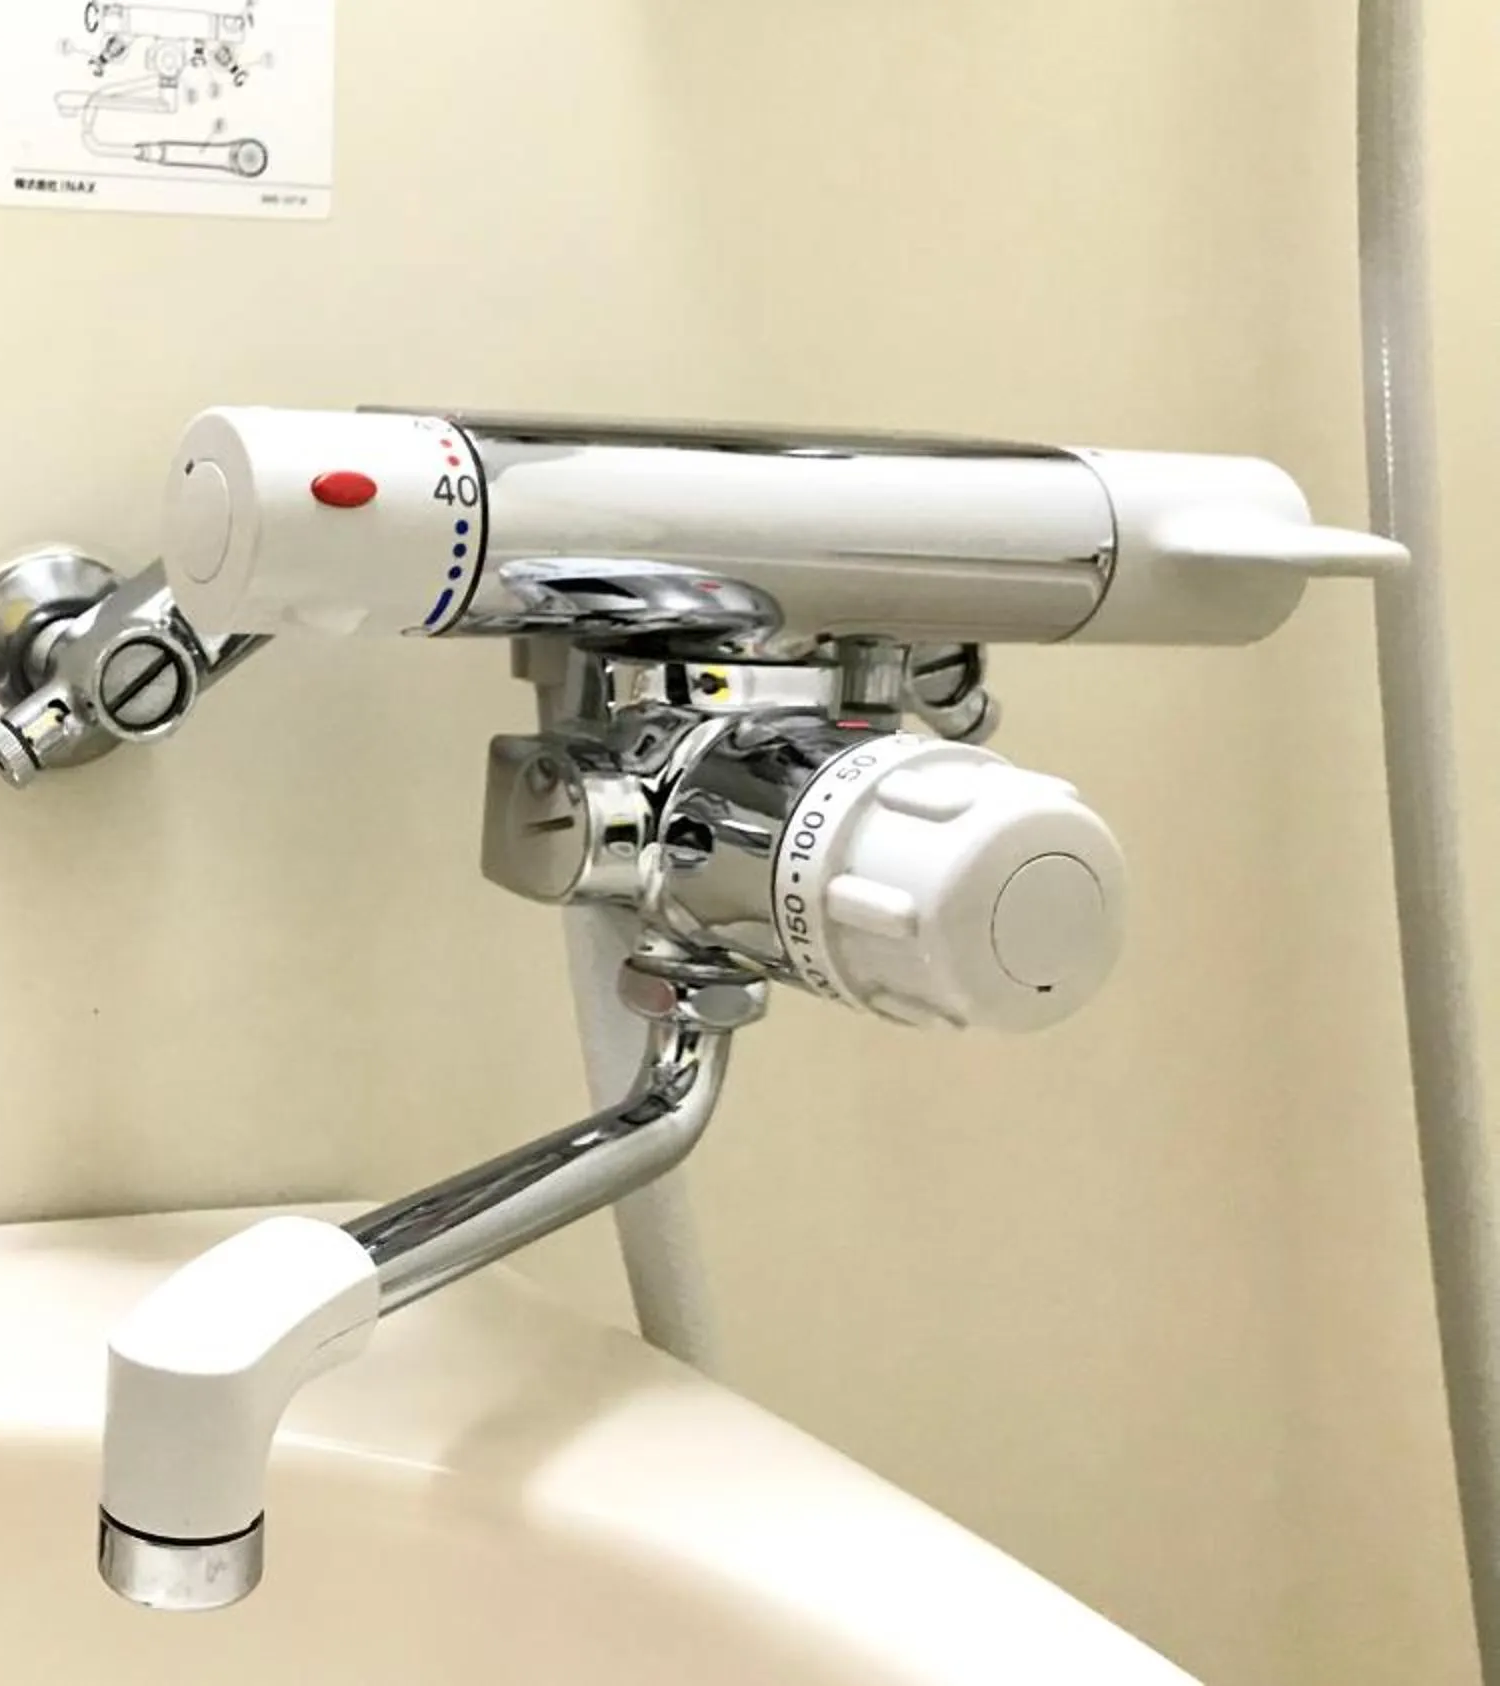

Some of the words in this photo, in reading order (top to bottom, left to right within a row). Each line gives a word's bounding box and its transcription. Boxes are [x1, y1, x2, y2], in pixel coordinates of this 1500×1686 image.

[434, 473, 478, 508] 40
[837, 754, 878, 782] 50
[790, 811, 825, 861] 100
[783, 893, 811, 945] 150
